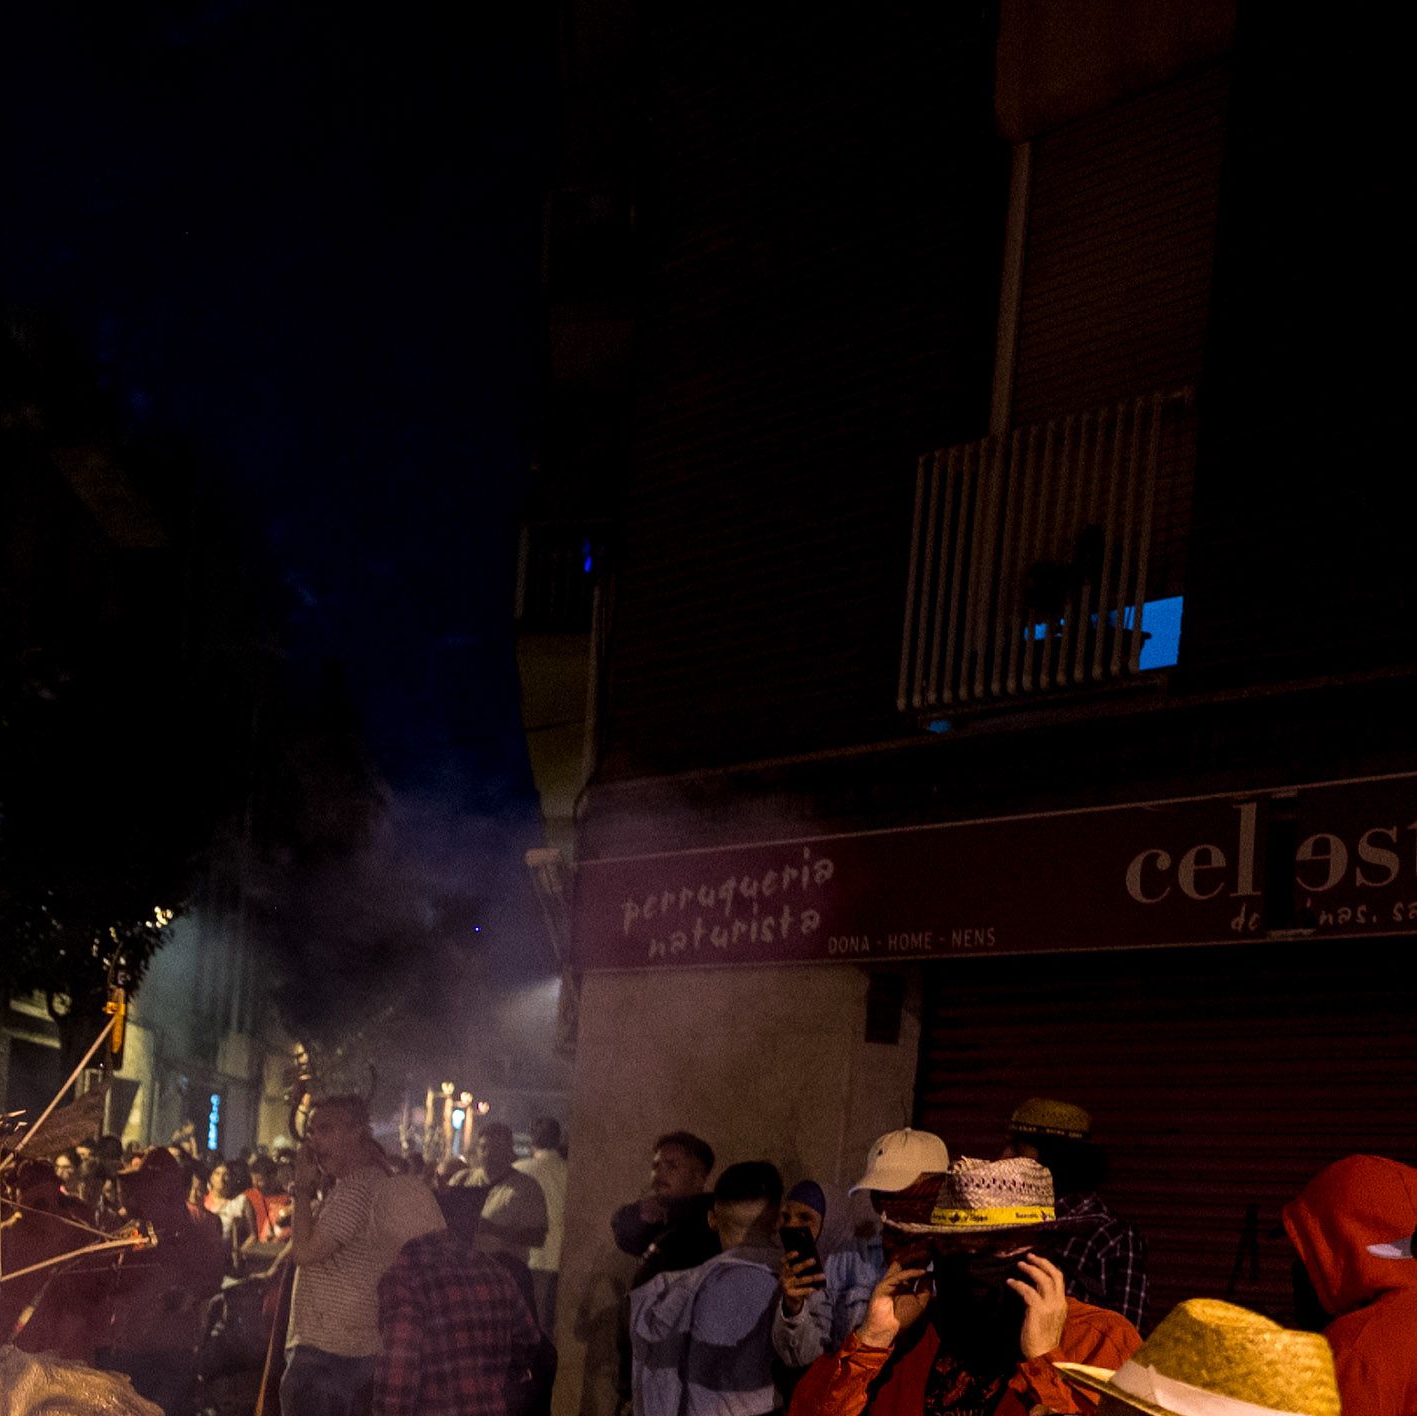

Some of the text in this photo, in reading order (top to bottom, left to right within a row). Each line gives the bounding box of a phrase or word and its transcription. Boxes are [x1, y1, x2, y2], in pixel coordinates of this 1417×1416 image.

[622, 847, 834, 935] perruqueria
[648, 901, 820, 958] naturista
[828, 935, 870, 955] DONA
[888, 931, 933, 951] HOME
[951, 927, 996, 948] NENS
